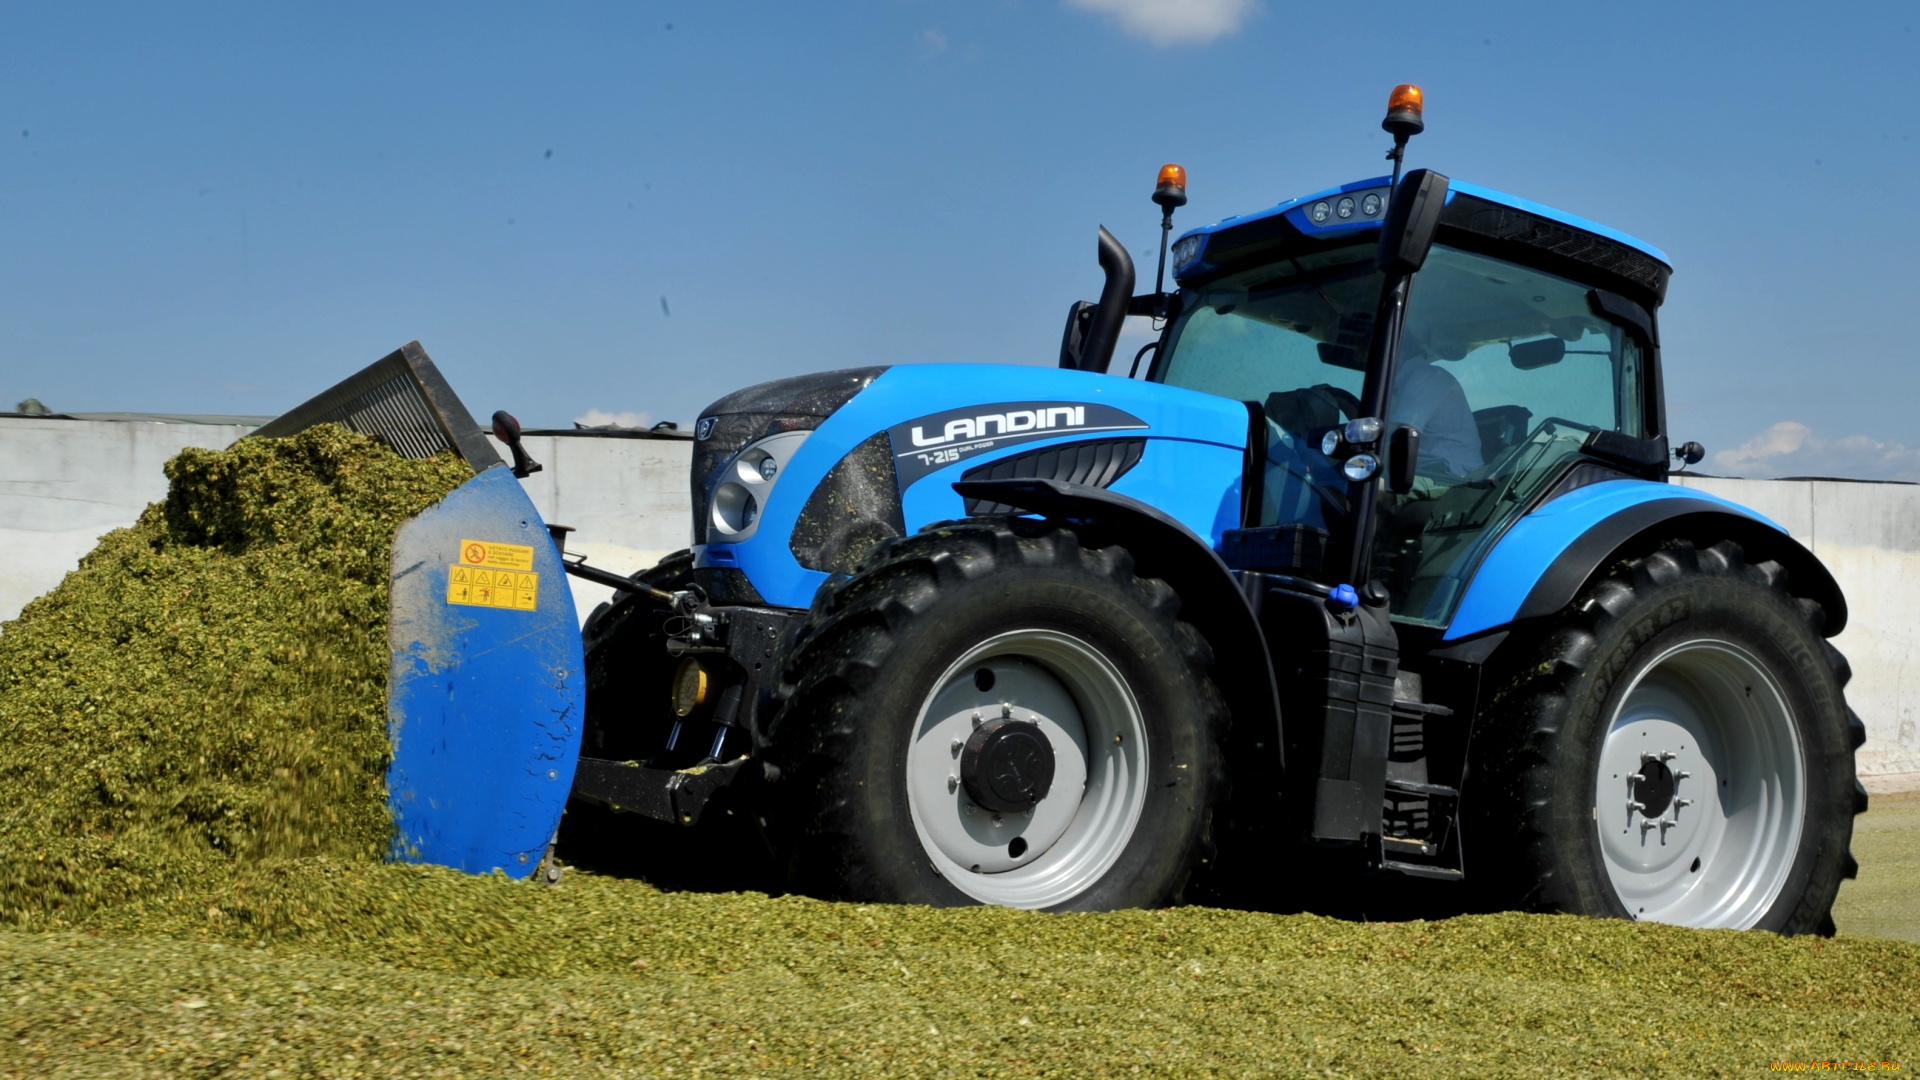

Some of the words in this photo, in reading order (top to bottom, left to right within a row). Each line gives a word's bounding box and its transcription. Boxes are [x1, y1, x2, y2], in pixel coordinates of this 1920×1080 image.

[912, 406, 1084, 447] LANDINI
[918, 448, 960, 466] 7-215
[959, 445, 974, 453] DUAL
